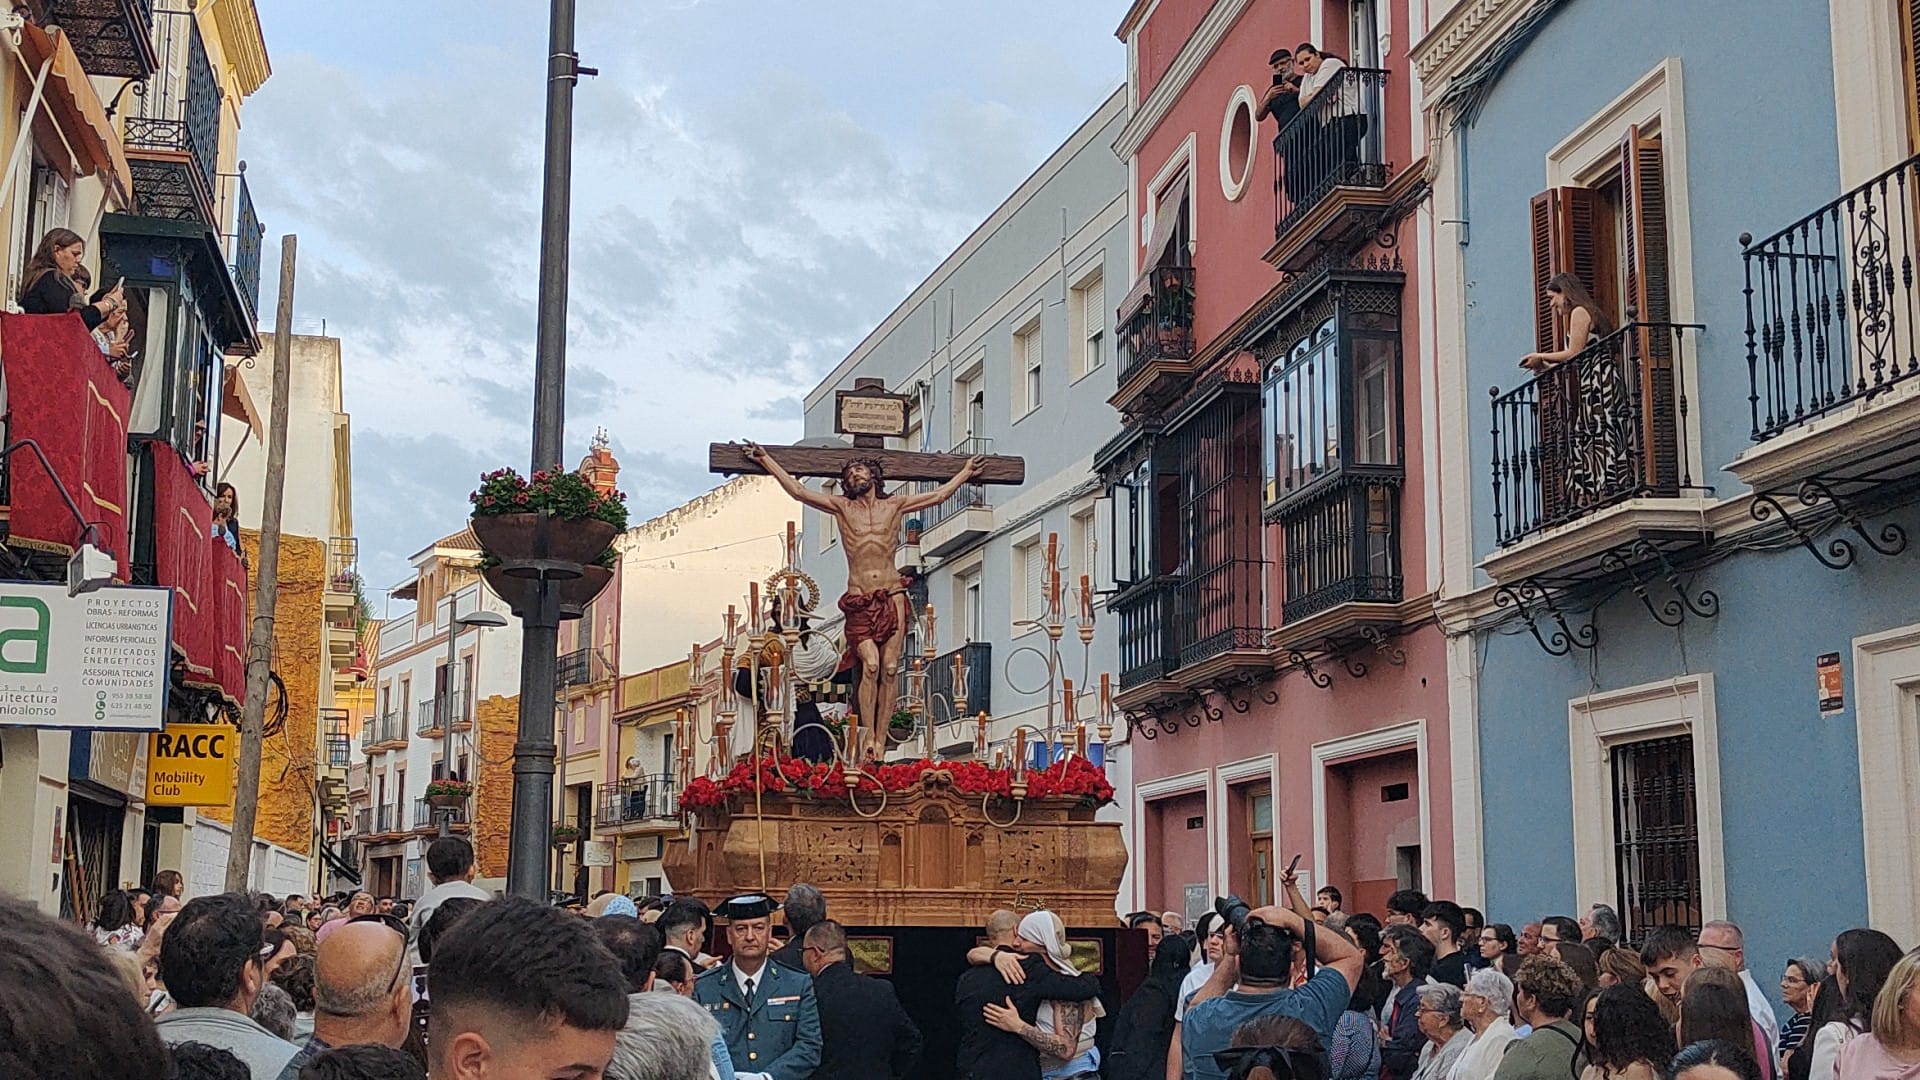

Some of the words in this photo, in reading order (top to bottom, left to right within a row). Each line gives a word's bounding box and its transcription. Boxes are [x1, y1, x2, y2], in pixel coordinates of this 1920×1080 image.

[87, 598, 160, 608] PROYECTOS
[86, 608, 112, 616] OBRAS
[118, 609, 159, 618] REFORMAS
[85, 621, 115, 630] LICENCIAS
[116, 622, 158, 631] URBANISTICAS
[0, 596, 50, 673] a
[84, 635, 119, 643] INFORMES
[120, 636, 157, 645] PERICIALES
[83, 647, 156, 656] CERTIFICADOS
[82, 668, 120, 677] ASESORIA
[122, 669, 154, 678] TECNICA
[81, 678, 154, 688] COMUNIDADES
[156, 733, 225, 759] RACC
[154, 771, 205, 786] Mobility
[153, 784, 181, 796] Club
